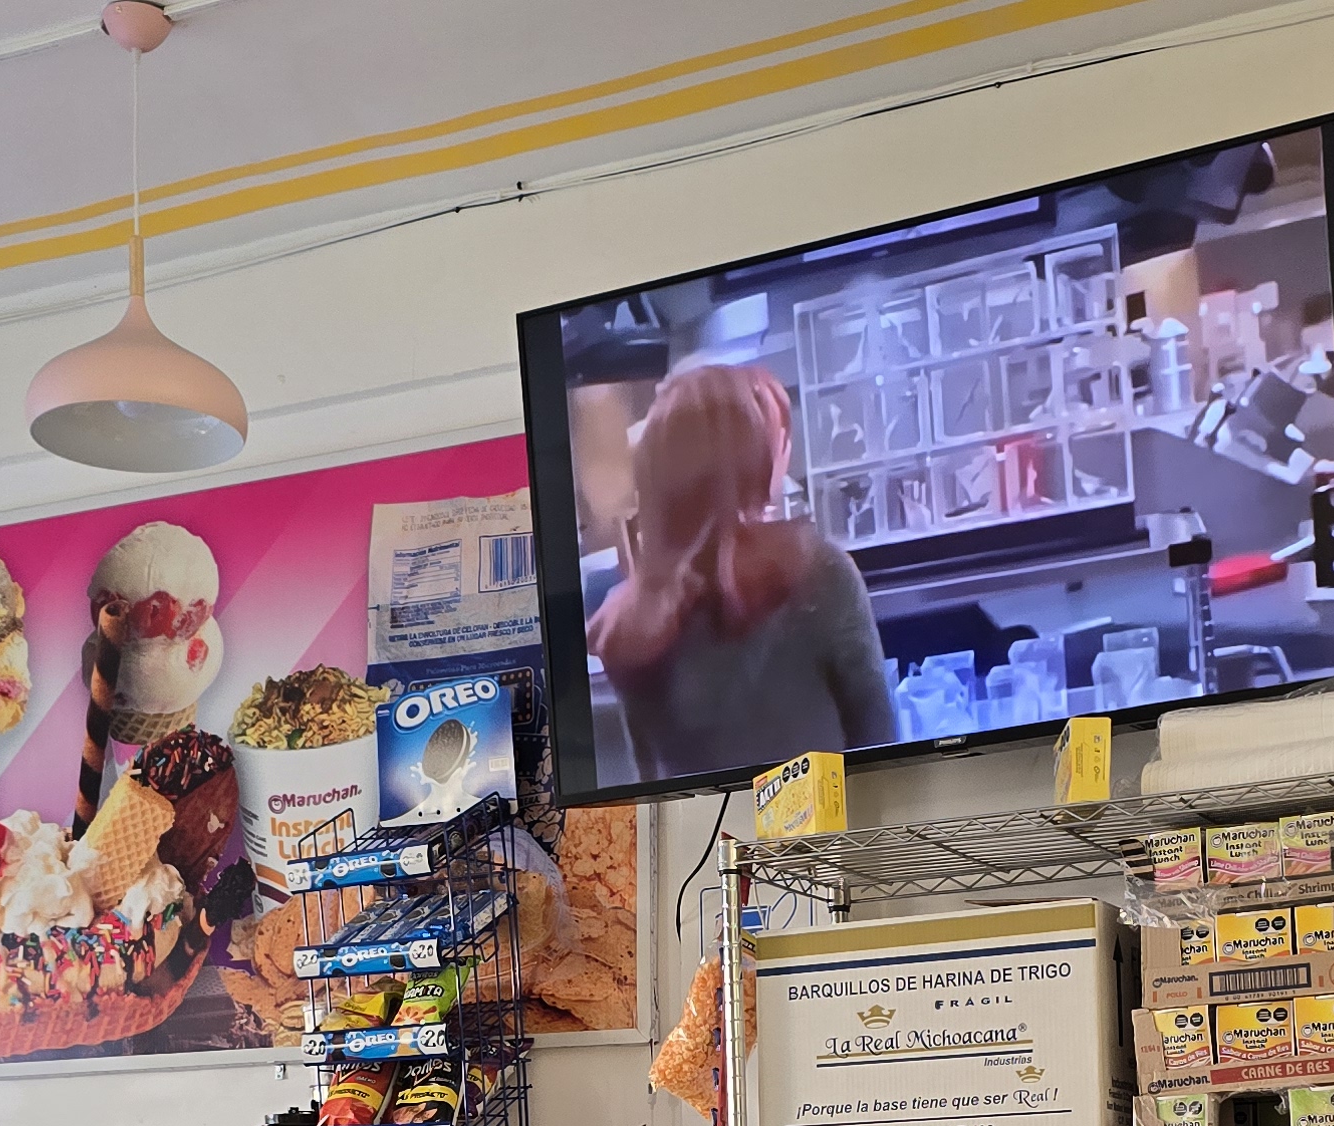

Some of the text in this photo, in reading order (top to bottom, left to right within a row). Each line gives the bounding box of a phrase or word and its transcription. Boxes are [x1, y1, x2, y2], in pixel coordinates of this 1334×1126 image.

[396, 679, 496, 728] OREO
[282, 784, 358, 808] Maruchan
[1144, 833, 1196, 849] Maruchan
[1222, 829, 1276, 842] Maruchan
[331, 855, 378, 878] OREO
[1233, 936, 1285, 949] Maruchan
[341, 947, 388, 967] OREO
[788, 961, 1072, 1001] BARQUILLOS DE HARINA DE TRIGO
[1160, 974, 1198, 985] Maruchan
[348, 1032, 396, 1053] OREO
[825, 1023, 1018, 1057] La Real Michoacana
[1233, 1027, 1286, 1039] Maruchan
[1241, 1060, 1331, 1080] CARNE DE RES
[1157, 1075, 1211, 1090] Maruchan
[796, 1101, 853, 1120] ¡Porque
[856, 1099, 869, 1113] la
[873, 1096, 908, 1112] base
[911, 1095, 948, 1110] tiene
[951, 1095, 980, 1113] que
[983, 1093, 1009, 1105] ser
[1013, 1088, 1051, 1109] Real
